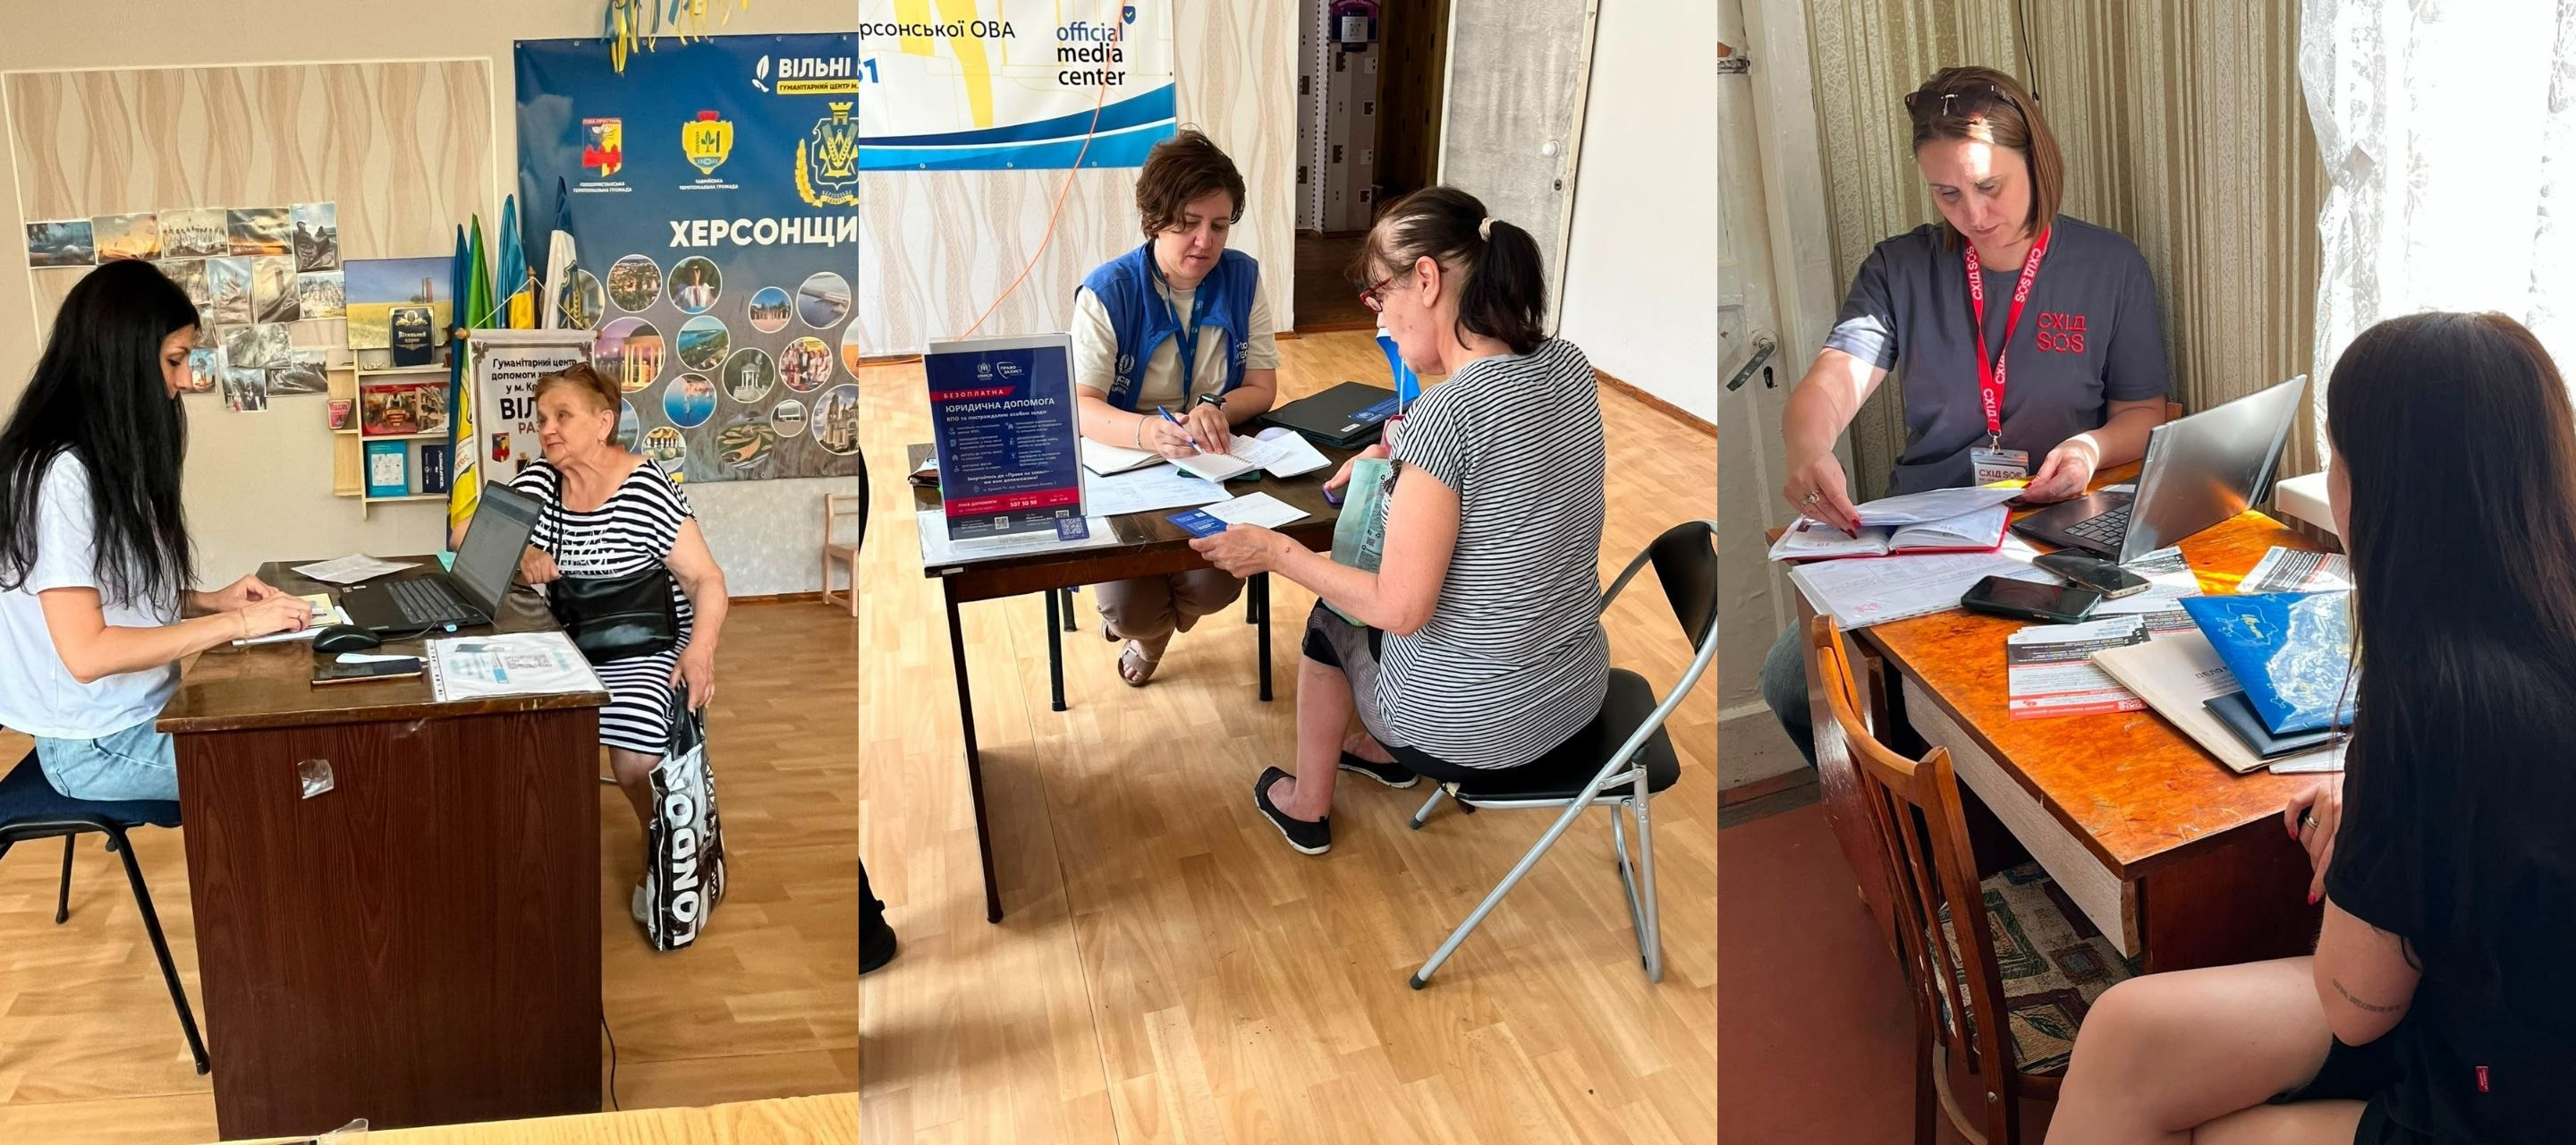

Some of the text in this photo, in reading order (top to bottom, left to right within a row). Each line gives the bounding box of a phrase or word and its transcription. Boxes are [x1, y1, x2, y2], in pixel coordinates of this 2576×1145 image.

[860, 21, 1016, 40] рсонської ОВА
[1056, 21, 1123, 42] official
[1057, 42, 1123, 63] media
[778, 57, 851, 78] ВІЛЬНІ
[1058, 69, 1126, 86] center
[669, 216, 858, 248] ХЕРСОНЩИ
[2037, 313, 2087, 331] СХІД
[2037, 332, 2085, 353] SOS
[492, 358, 552, 369] Гуманітарний
[491, 371, 537, 381] допомоги
[505, 385, 512, 394] у
[944, 388, 1004, 399] БЕЗОПЛАТНА
[945, 397, 1055, 413] ЮРИДИЧНА ДОПОМОГА
[518, 420, 539, 435] РА
[1979, 469, 2002, 479] СХІД
